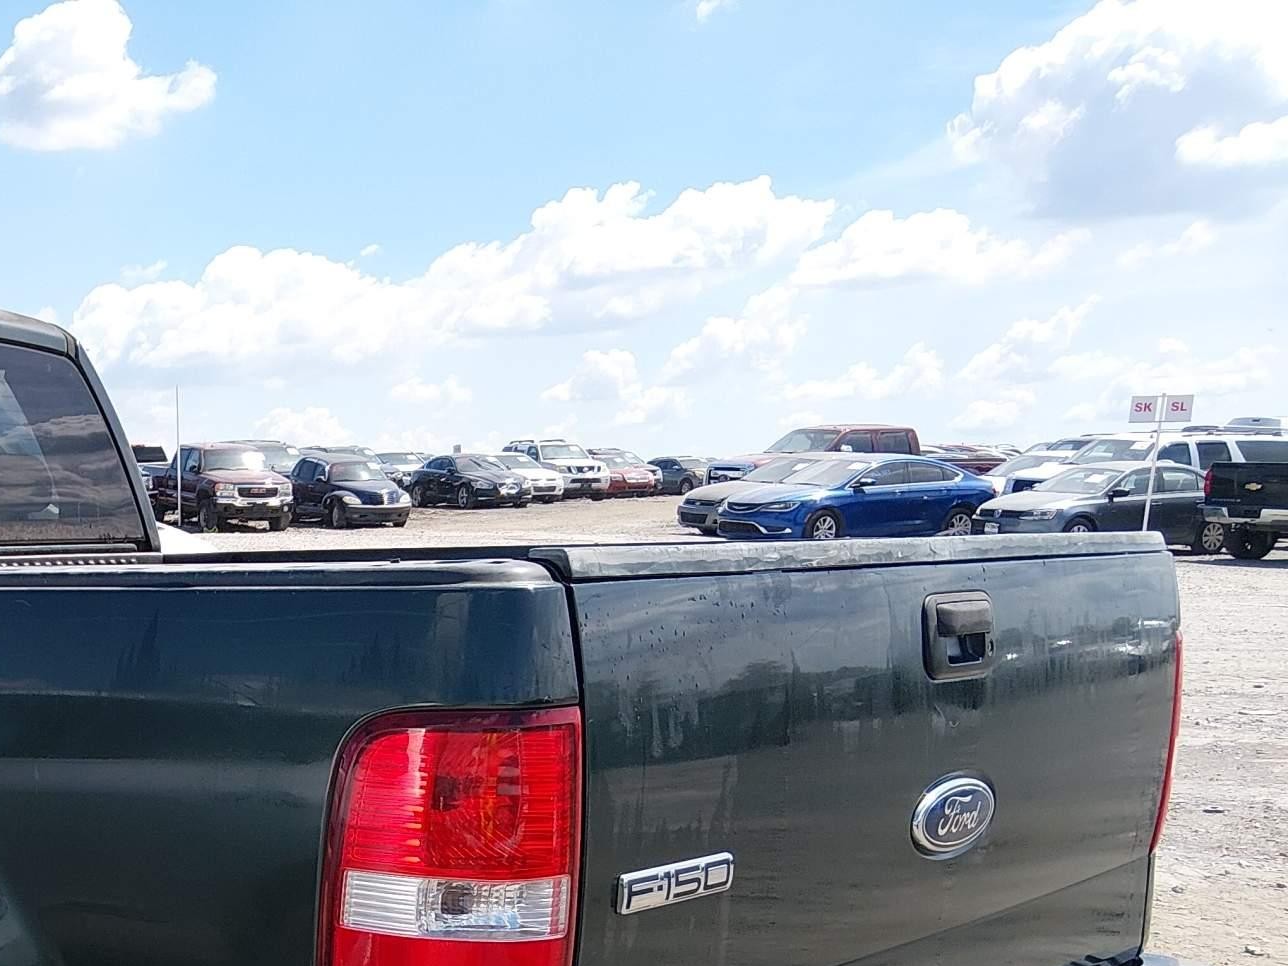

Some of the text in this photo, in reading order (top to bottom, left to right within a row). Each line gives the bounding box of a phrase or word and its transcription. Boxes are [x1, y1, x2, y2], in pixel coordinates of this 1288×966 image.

[1134, 402, 1153, 413] SK
[1170, 401, 1188, 412] SL
[937, 794, 982, 836] Ford
[625, 858, 731, 910] F-150
